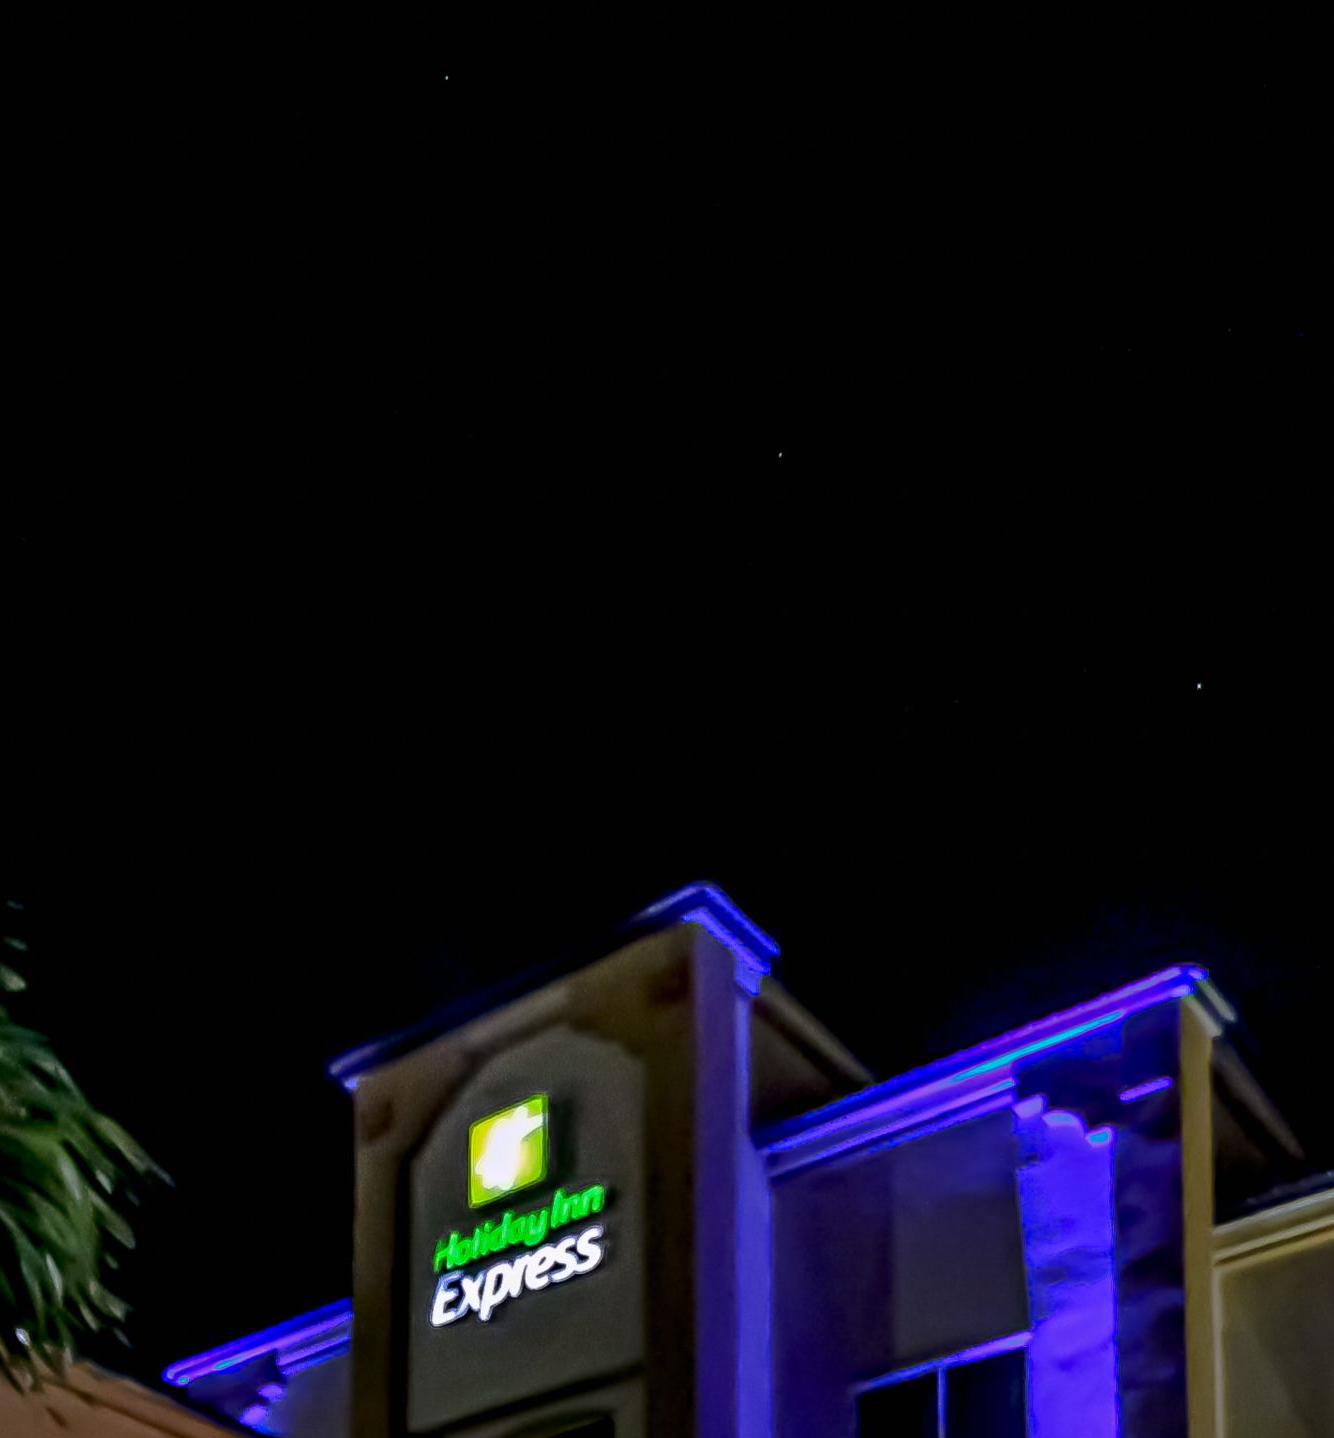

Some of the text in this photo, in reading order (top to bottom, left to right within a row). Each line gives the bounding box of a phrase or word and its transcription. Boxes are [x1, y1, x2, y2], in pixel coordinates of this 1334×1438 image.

[433, 1184, 605, 1272] Holiday Inn
[429, 1226, 603, 1327] Express
